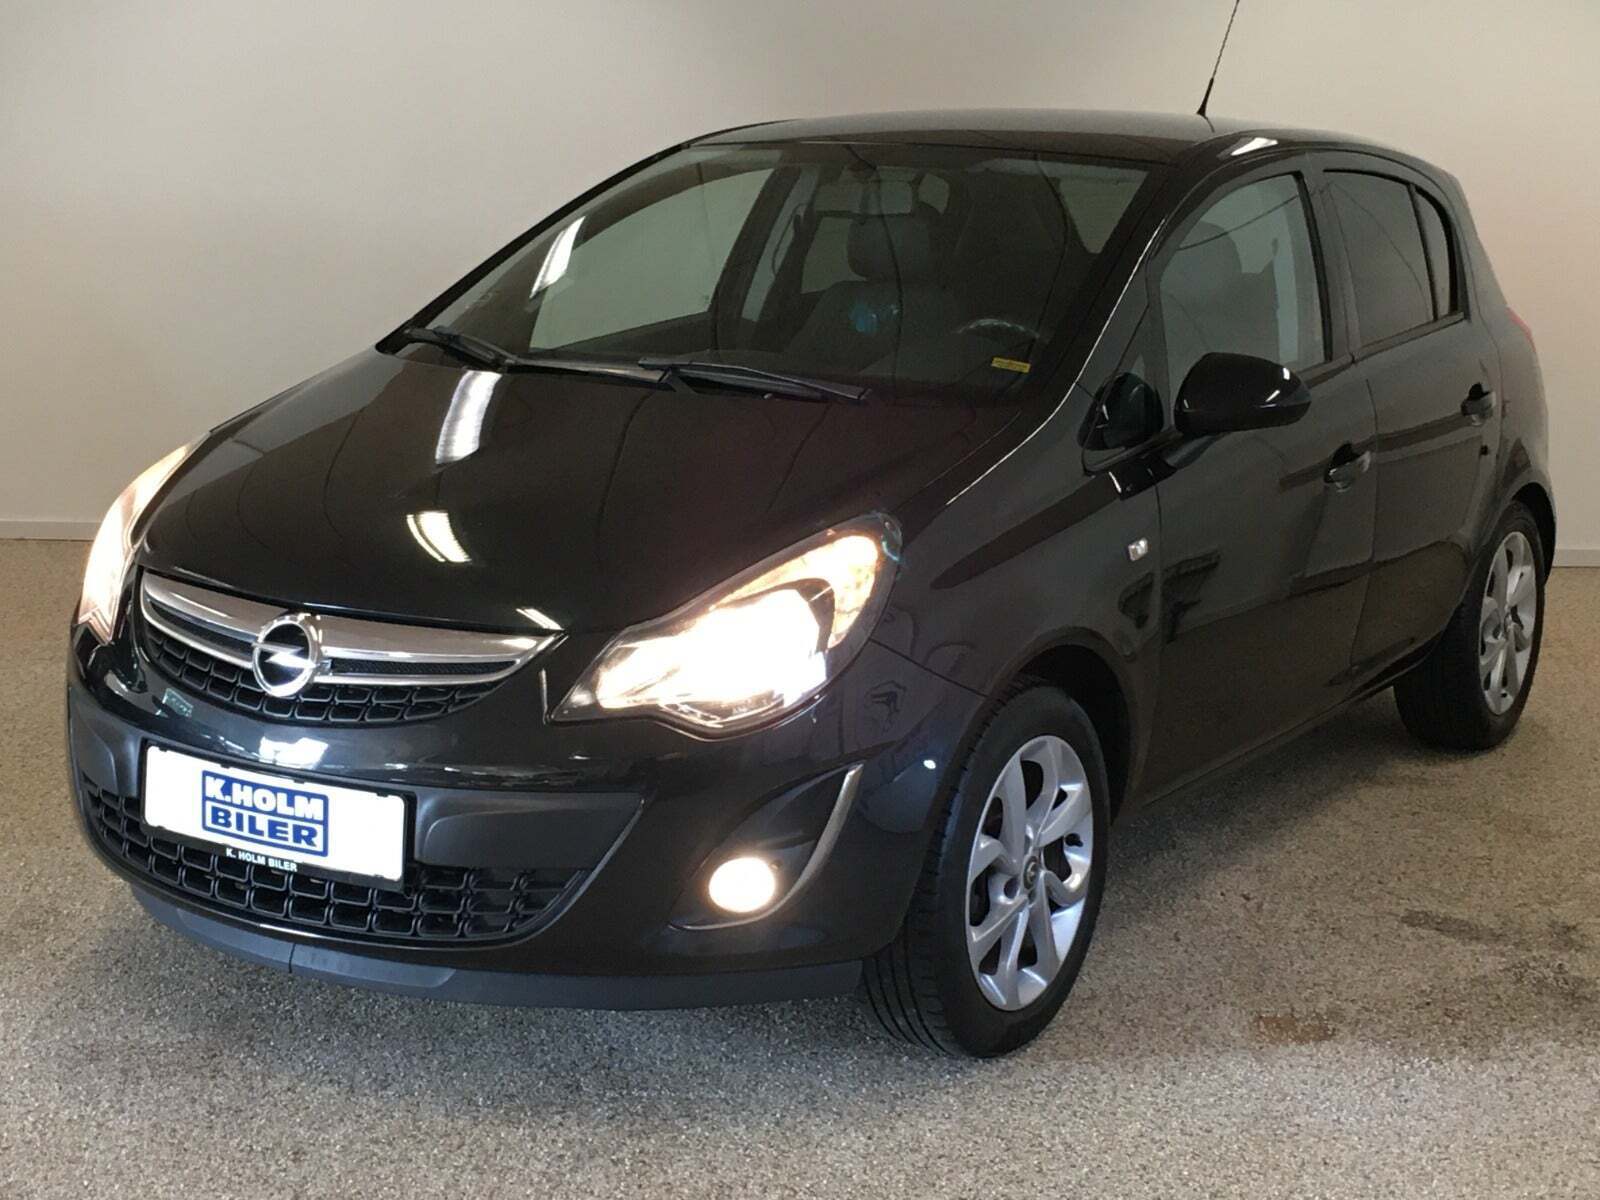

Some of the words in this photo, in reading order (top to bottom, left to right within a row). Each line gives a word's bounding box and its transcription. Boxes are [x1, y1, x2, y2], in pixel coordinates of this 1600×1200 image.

[204, 775, 324, 821] K.HOLM
[211, 805, 318, 847] BILER
[226, 847, 236, 858] K.
[238, 850, 266, 866] HOLM
[268, 858, 298, 873] BILER
